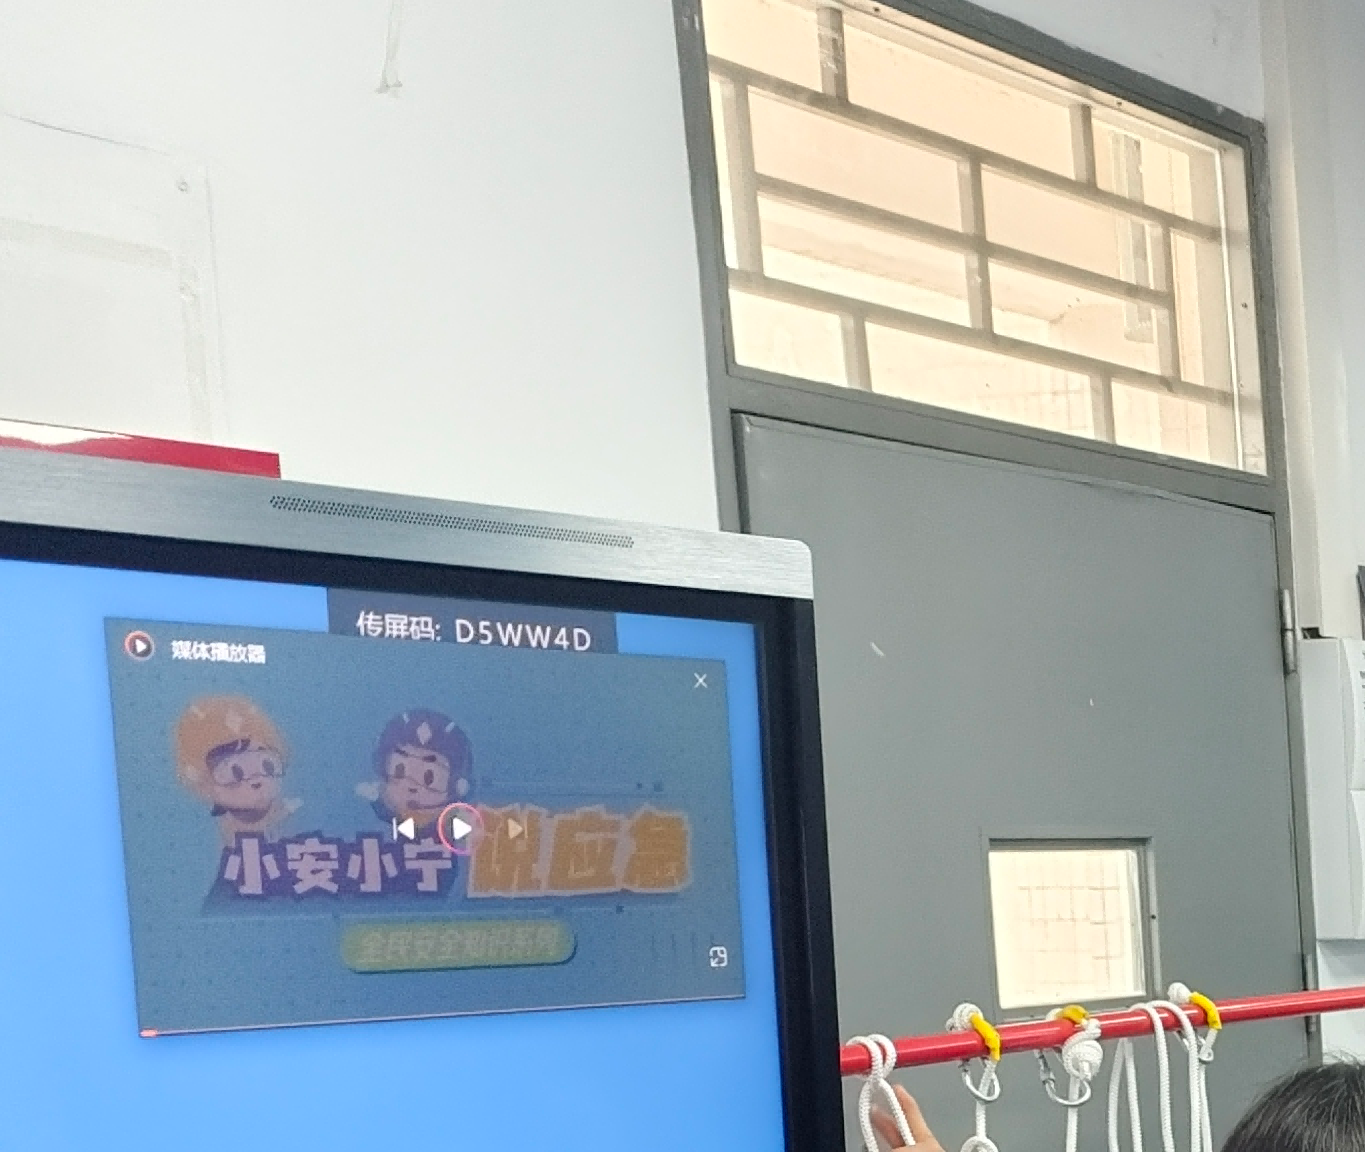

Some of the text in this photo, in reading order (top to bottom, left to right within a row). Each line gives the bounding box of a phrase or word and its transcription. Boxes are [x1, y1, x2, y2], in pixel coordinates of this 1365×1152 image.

[455, 618, 591, 651] D5WW4D
[171, 640, 267, 664] 媒体播放器
